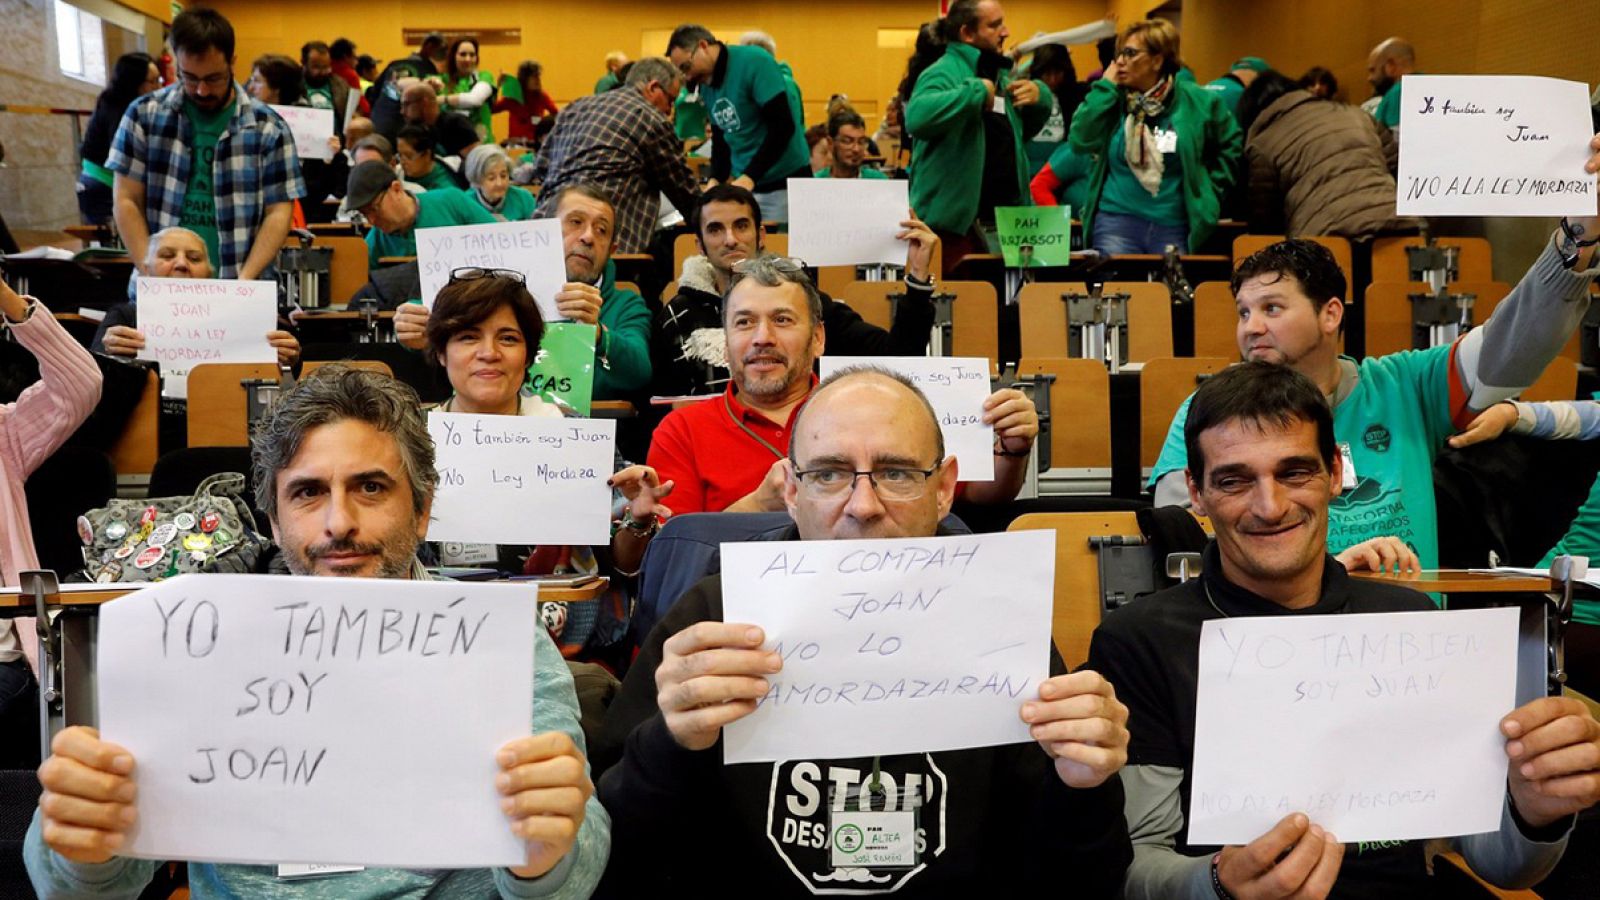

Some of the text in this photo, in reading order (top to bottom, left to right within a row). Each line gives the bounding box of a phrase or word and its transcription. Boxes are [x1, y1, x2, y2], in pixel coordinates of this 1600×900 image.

[1419, 96, 1434, 114] Yo
[1496, 107, 1515, 120] soy
[1506, 125, 1549, 142] Juan
[1491, 177, 1527, 195] LEY
[1014, 217, 1039, 229] PAH
[429, 237, 453, 257] YO
[425, 258, 452, 276] SOY
[141, 281, 160, 295] YO
[235, 286, 256, 297] SOY
[170, 303, 210, 317] JOAN
[207, 328, 228, 340] LEY
[154, 347, 221, 360] MORDAZA
[531, 374, 572, 393] CAS
[929, 373, 951, 386] soy
[951, 366, 983, 380] Juan
[942, 412, 980, 426] daza
[443, 421, 462, 445] Yo
[538, 436, 562, 449] soy
[567, 427, 611, 442] Juan
[492, 469, 523, 489] Ley
[537, 463, 597, 484] Mordaza
[760, 543, 981, 578] AL COMPAH
[833, 585, 951, 620] JOAN
[154, 597, 490, 662] YO TAMBIÉN
[857, 632, 902, 657] LO
[1219, 627, 1481, 681] YO TAMBIEN
[235, 672, 328, 716] SOY
[1293, 674, 1444, 702] SOY JUAN
[188, 747, 327, 786] JOAN
[786, 762, 934, 817] STOP
[872, 832, 901, 844] ALTEA
